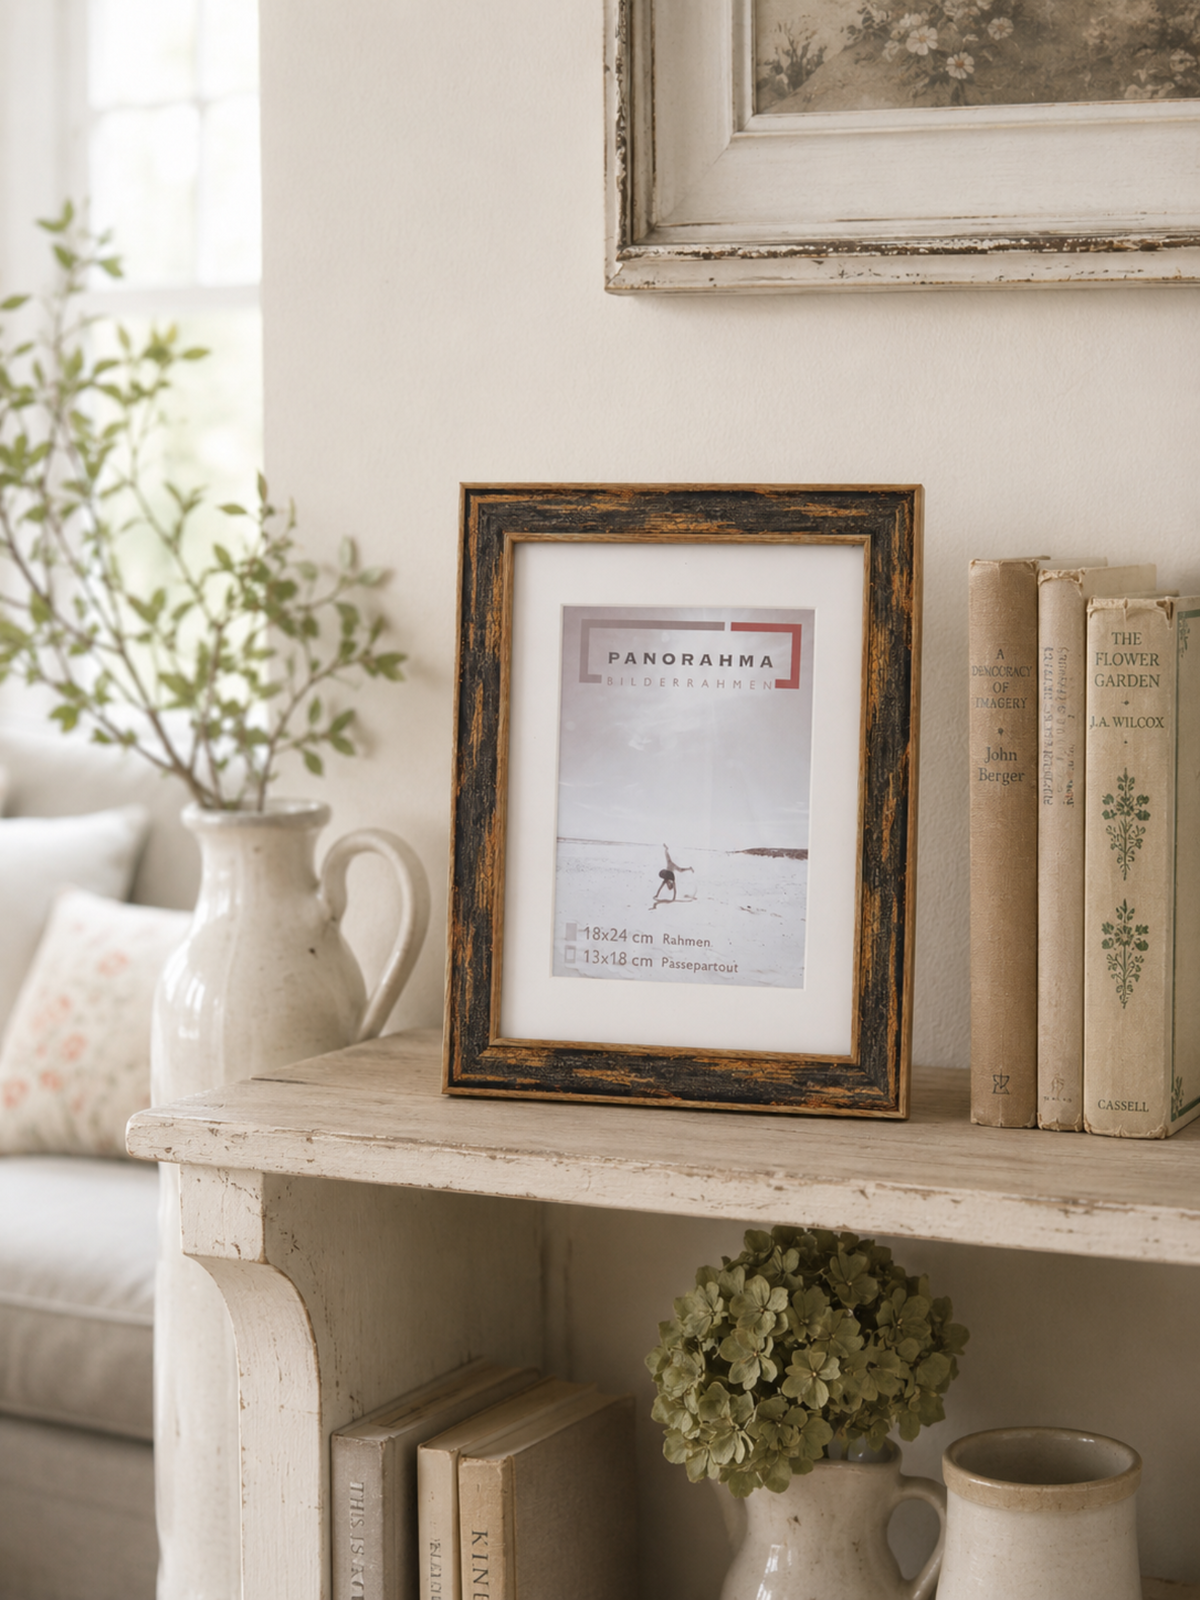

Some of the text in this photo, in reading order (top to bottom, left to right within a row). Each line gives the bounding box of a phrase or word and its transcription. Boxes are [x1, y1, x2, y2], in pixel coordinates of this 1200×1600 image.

[1111, 632, 1142, 645] THE
[608, 652, 774, 668] PANORAHMA
[996, 648, 1005, 660] A
[1095, 652, 1160, 667] FLOWER
[607, 677, 773, 690] BILDERRAHMEN
[992, 681, 1010, 694] OF
[1094, 674, 1161, 688] GARDEN
[975, 697, 1028, 709] IMAGERY
[1113, 716, 1165, 728] WILCOX
[984, 747, 1018, 763] John
[978, 768, 1025, 786] Berger
[583, 926, 711, 948] 18x24 cm Rahmen
[583, 949, 739, 973] 13x18 cm Passepartout
[1097, 1099, 1150, 1112] CASSELL
